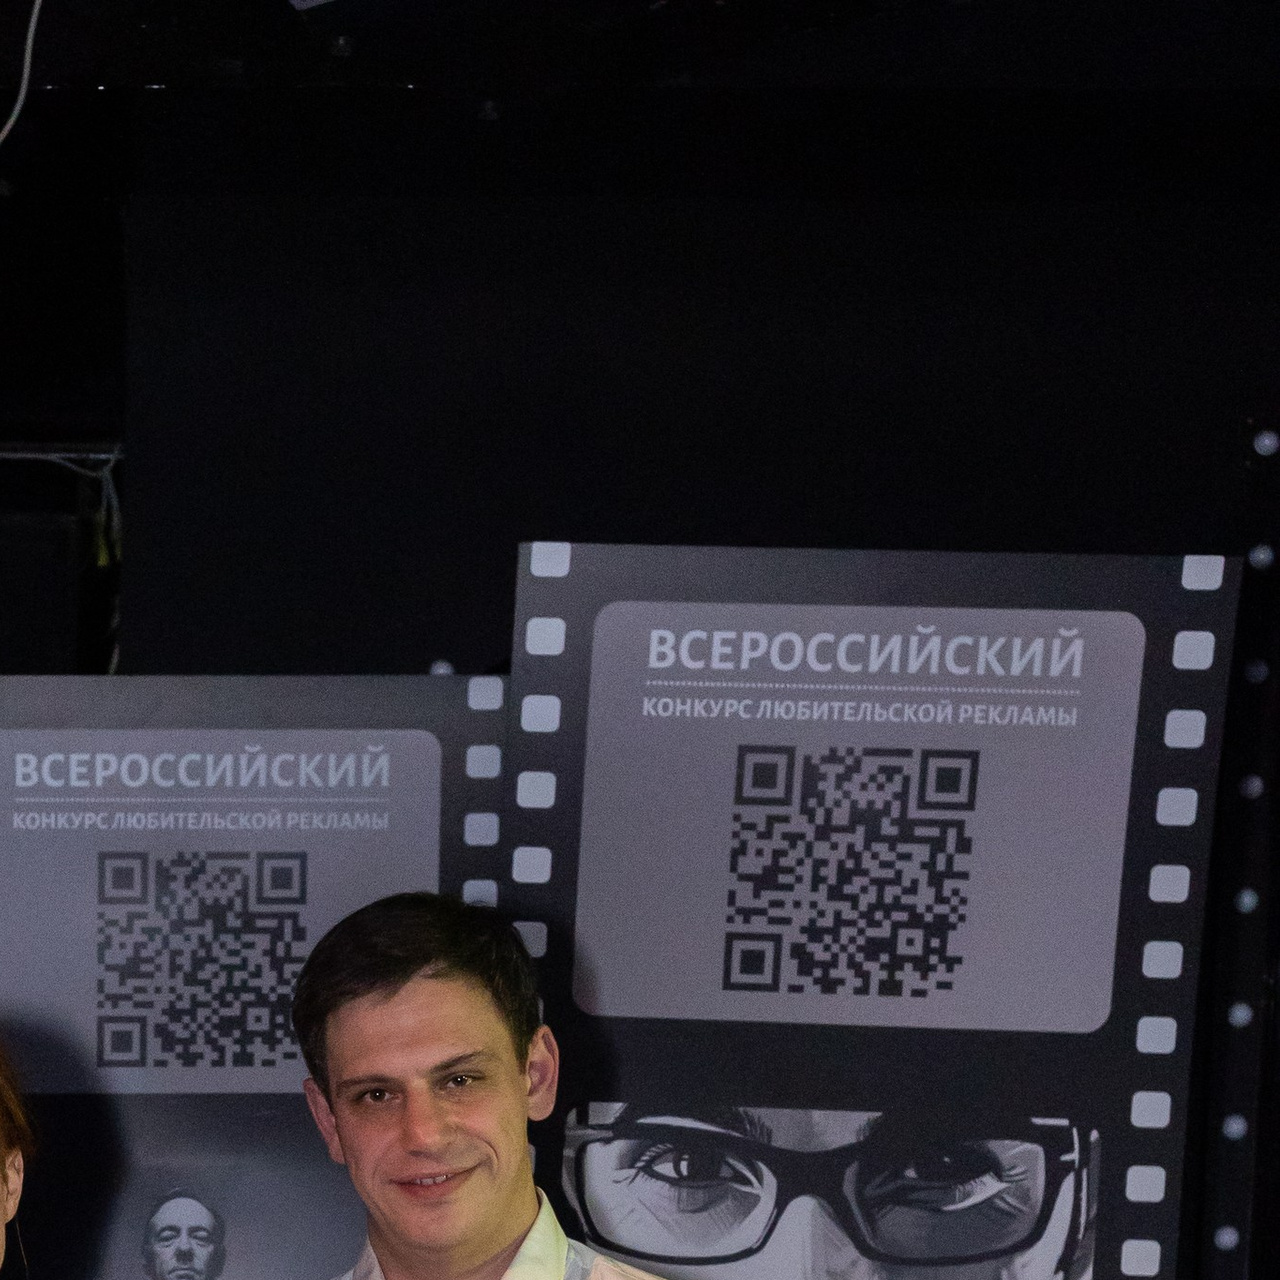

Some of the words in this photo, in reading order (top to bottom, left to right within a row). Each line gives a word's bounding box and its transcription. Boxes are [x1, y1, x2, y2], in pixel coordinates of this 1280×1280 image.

[646, 624, 1085, 678] ВСЕРОССИЙСКИЙ
[642, 697, 754, 719] КОНКУРС
[755, 697, 954, 724] ЛЮБИТЕЛЬСКОЙ
[958, 704, 1078, 727] РЕКЛАМЫ
[14, 744, 392, 789] ВСЕРОССИЙСКИЙ
[12, 811, 110, 831] КОНКУРС
[110, 808, 282, 831] ЛЮБИТЕЛЬСКОЙ
[287, 811, 390, 831] РЕКЛАМЫ
